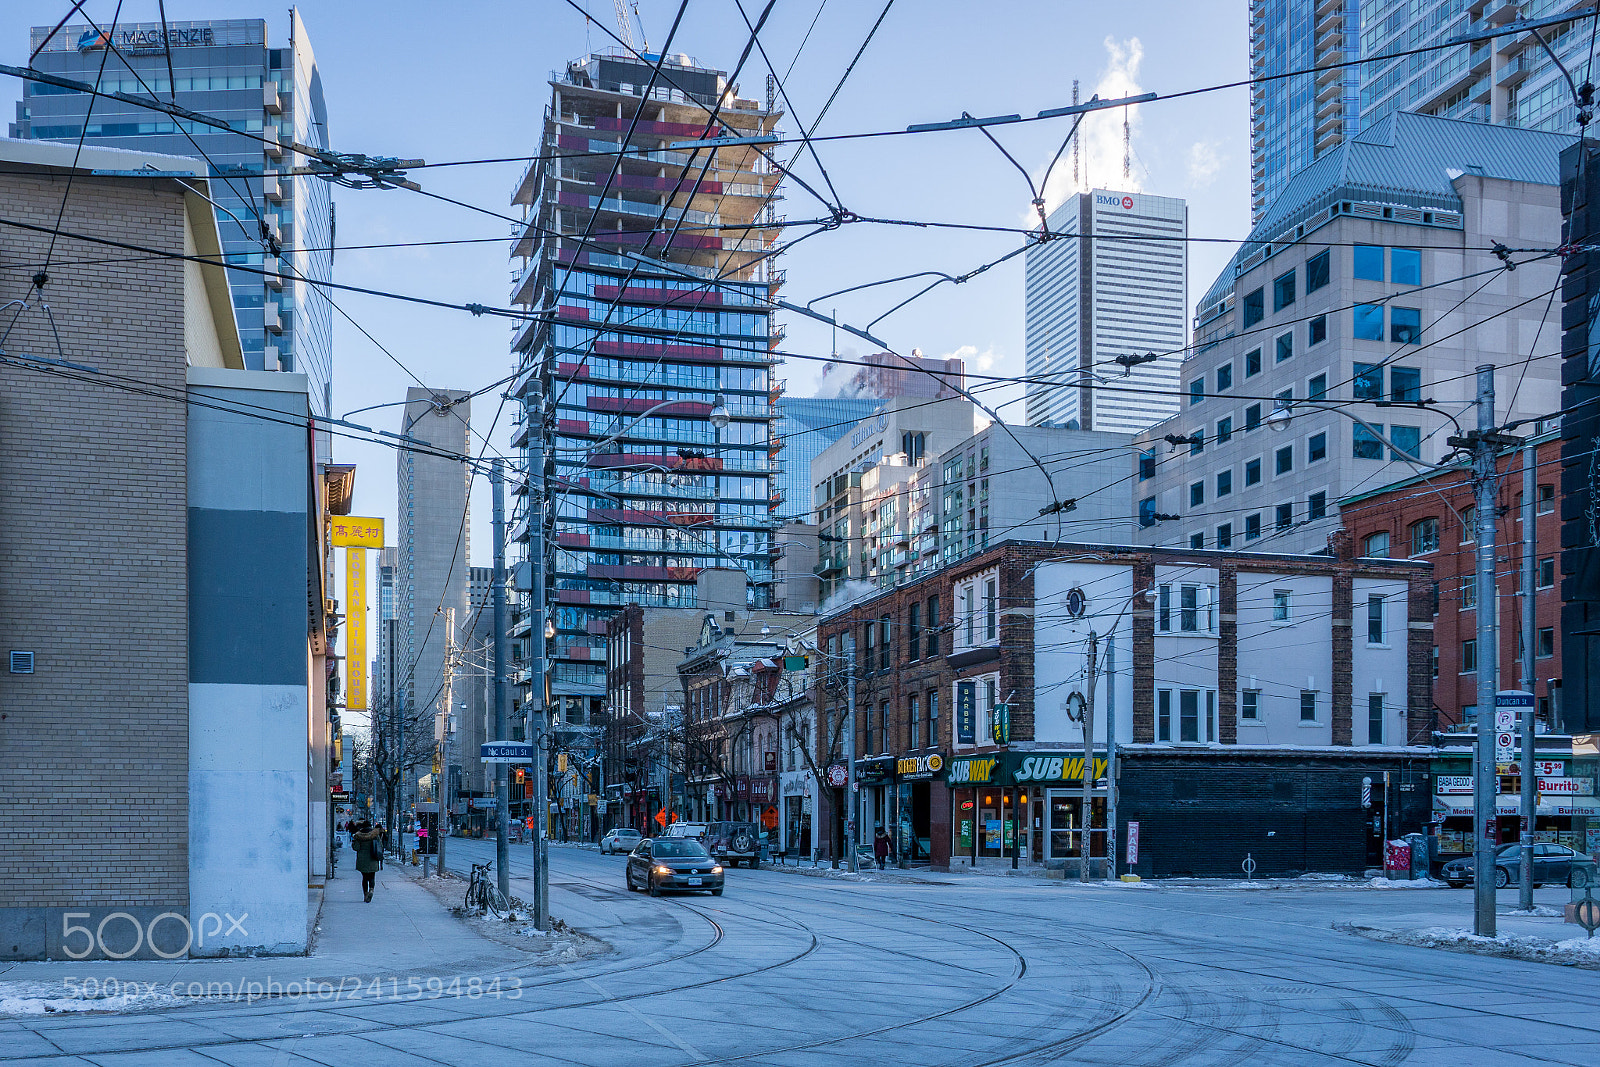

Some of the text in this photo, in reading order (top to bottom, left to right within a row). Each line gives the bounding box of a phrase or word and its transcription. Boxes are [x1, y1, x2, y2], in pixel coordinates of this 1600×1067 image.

[122, 28, 212, 43] MACKENZIE
[1096, 195, 1120, 206] BMO
[351, 552, 360, 705] KOREAN GRILL HOUSE
[1496, 697, 1520, 706] Duncan
[520, 748, 527, 756] St
[949, 759, 995, 783] SUBWAY
[1014, 757, 1108, 781] SUBWAY
[1538, 780, 1579, 791] Burrito
[1128, 828, 1137, 863] PARK
